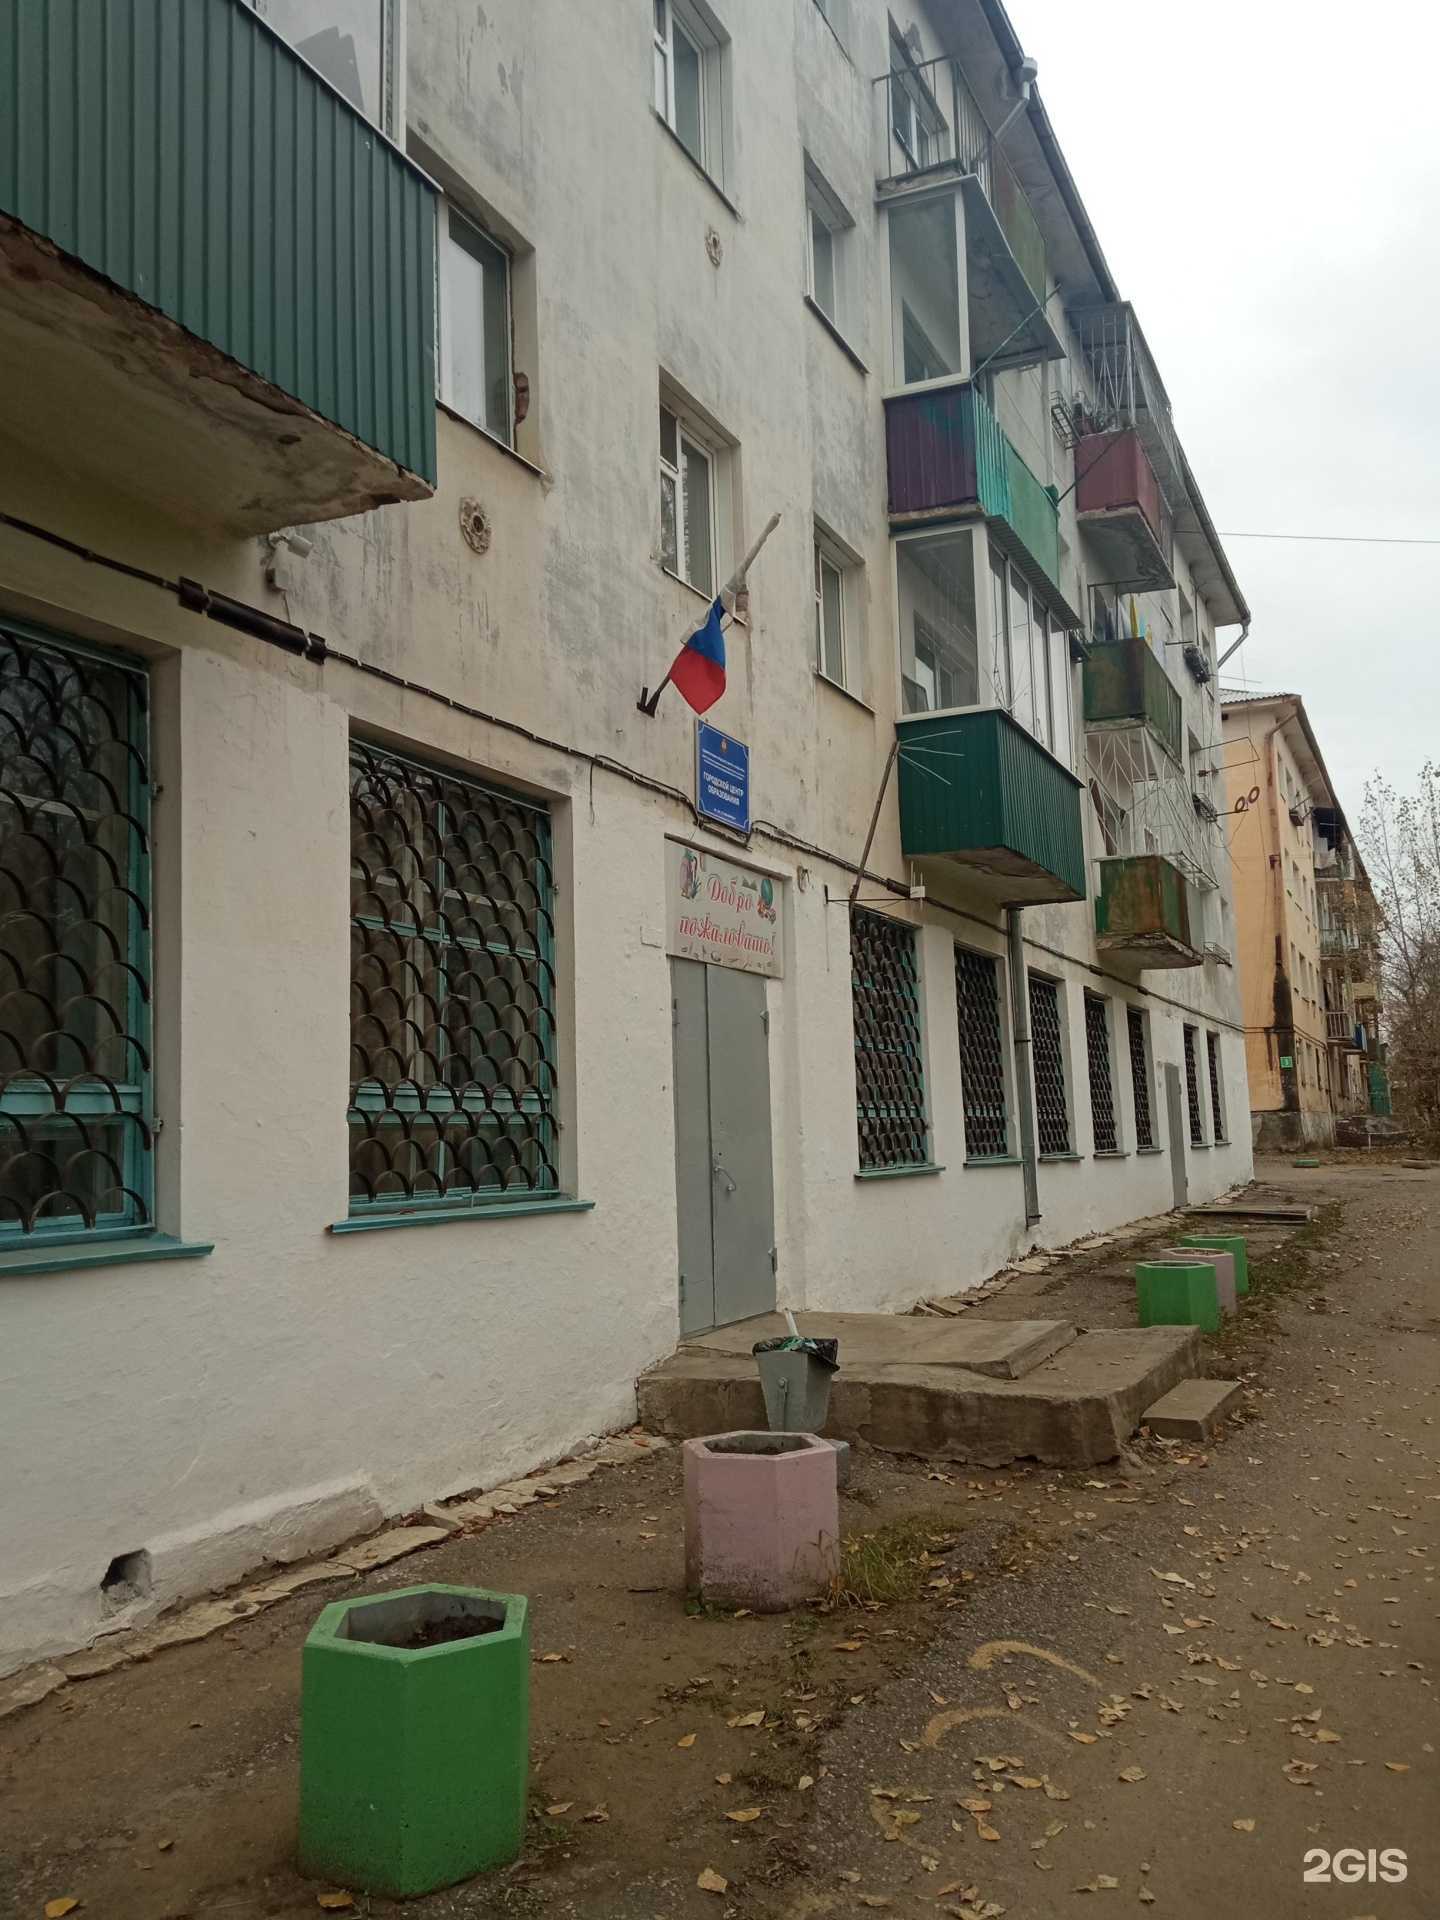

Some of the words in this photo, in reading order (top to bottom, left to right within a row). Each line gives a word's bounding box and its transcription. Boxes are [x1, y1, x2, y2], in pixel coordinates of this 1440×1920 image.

[704, 771, 729, 791] ГОРОДСКОЙ
[730, 784, 744, 797] ЦЕНТР
[708, 784, 740, 806] ОБРАЗОВАНИЯ
[708, 874, 751, 912] Добро
[680, 913, 776, 955] пожаловать!
